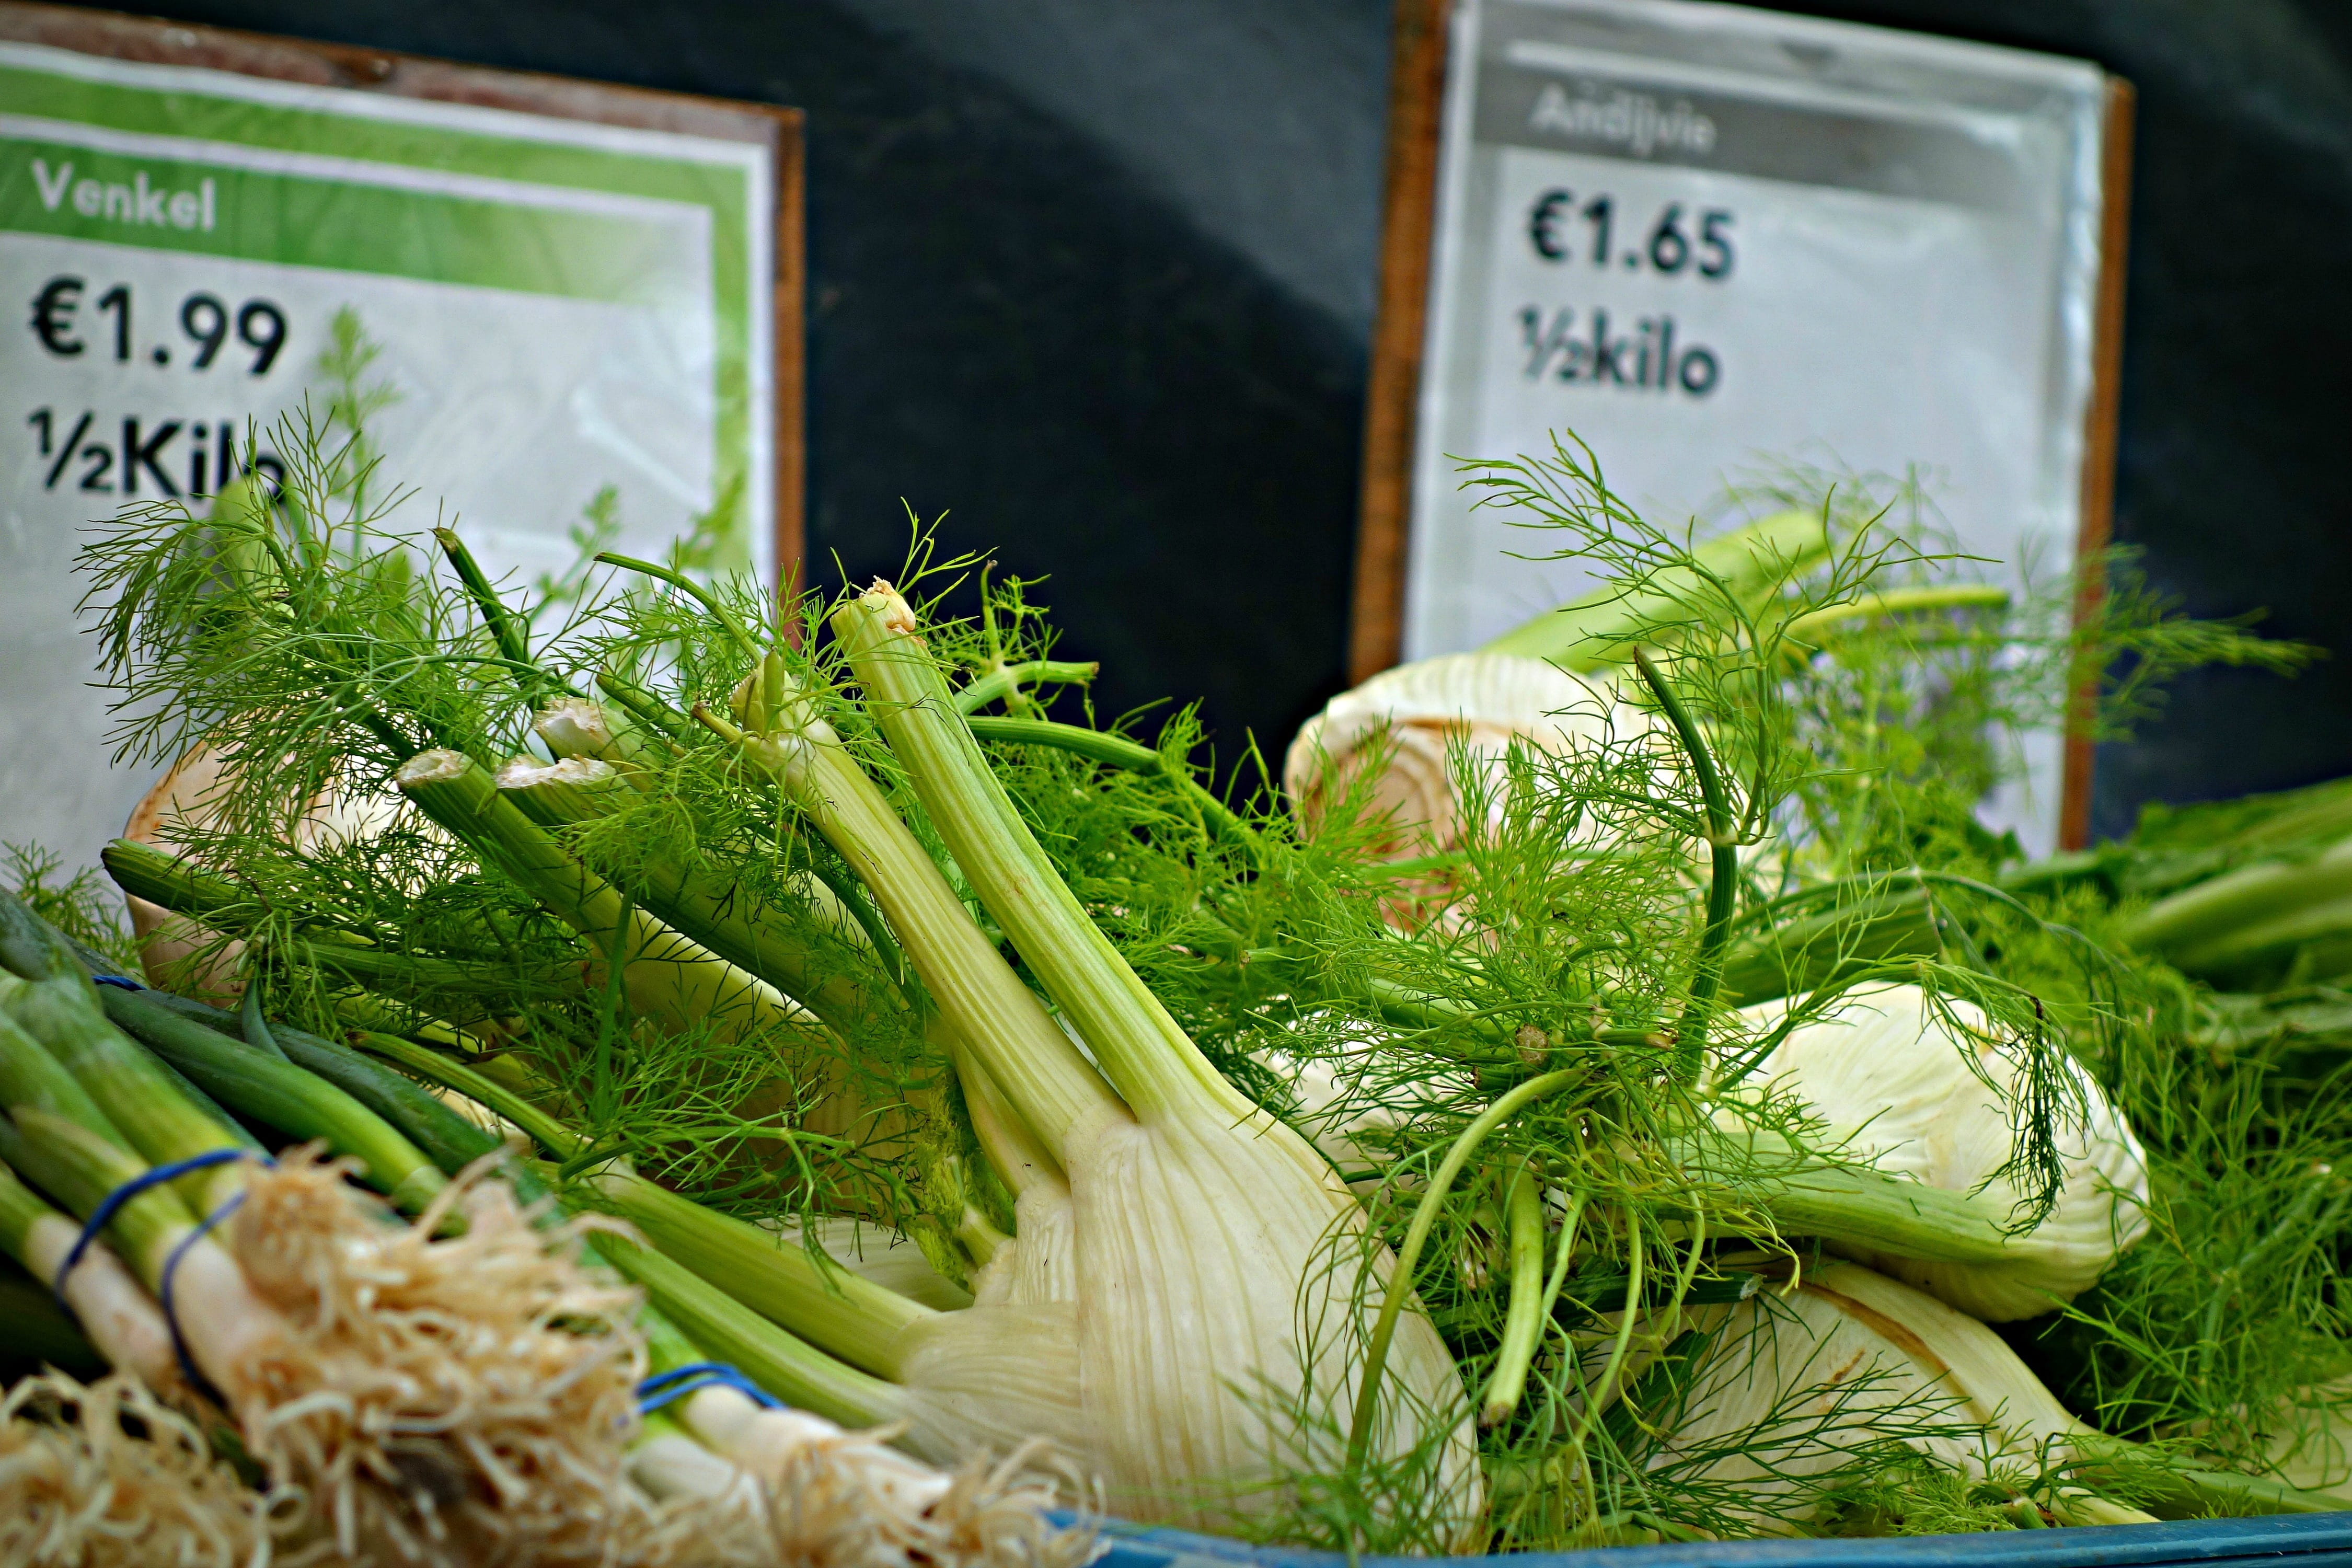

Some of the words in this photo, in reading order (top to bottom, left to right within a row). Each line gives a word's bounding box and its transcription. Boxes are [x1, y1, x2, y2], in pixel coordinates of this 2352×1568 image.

[31, 159, 217, 230] Venkel
[1528, 188, 1735, 280] €1.65
[30, 274, 289, 375] €1.99
